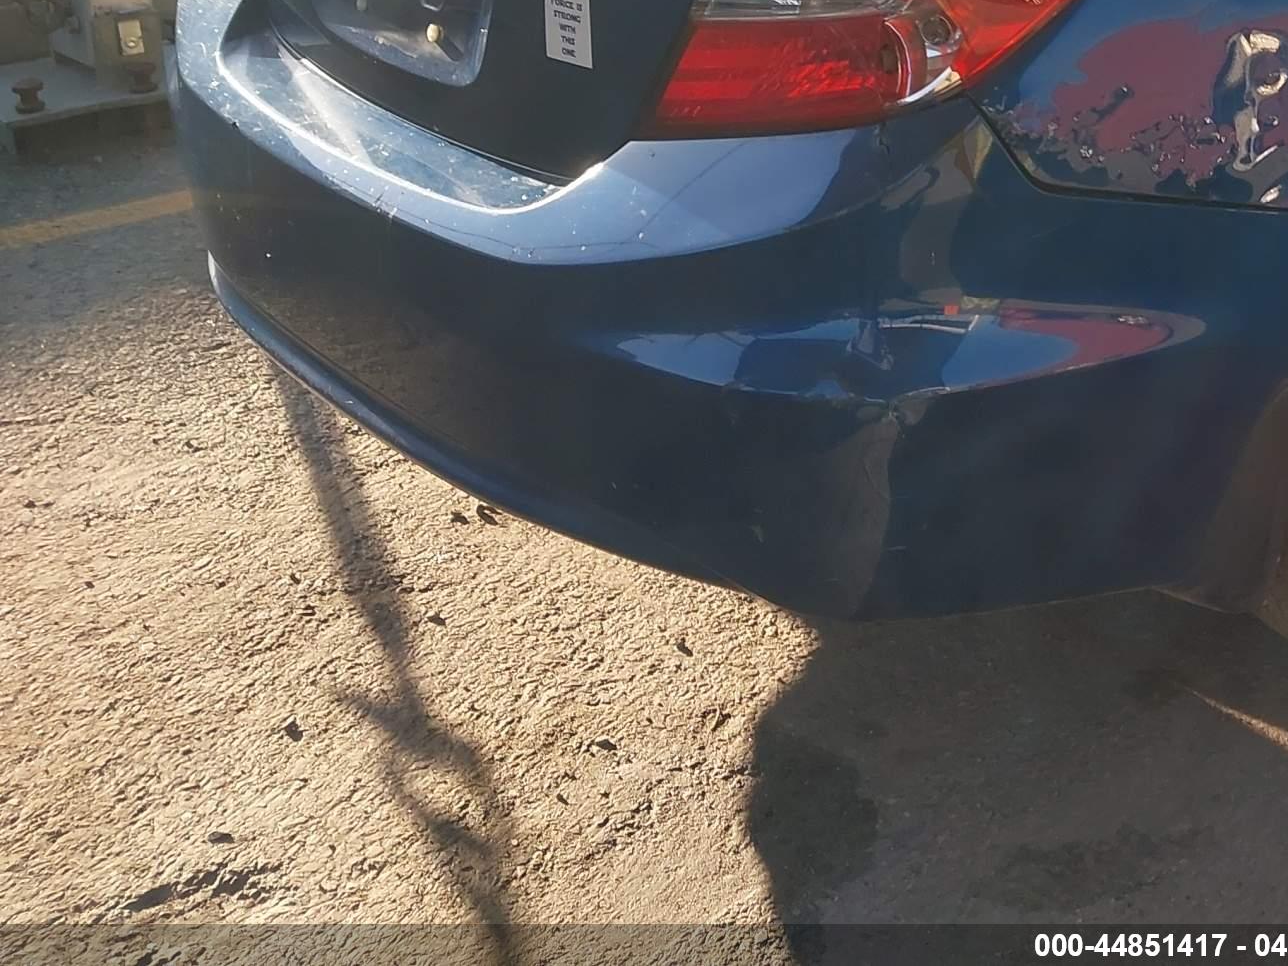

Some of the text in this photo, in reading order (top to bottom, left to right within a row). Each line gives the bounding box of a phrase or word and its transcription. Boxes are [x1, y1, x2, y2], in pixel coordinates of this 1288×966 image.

[576, 3, 583, 12] IS
[553, 9, 582, 23] STRONG
[559, 22, 576, 34] WITH
[560, 35, 576, 46] THIS
[561, 47, 576, 58] ONE
